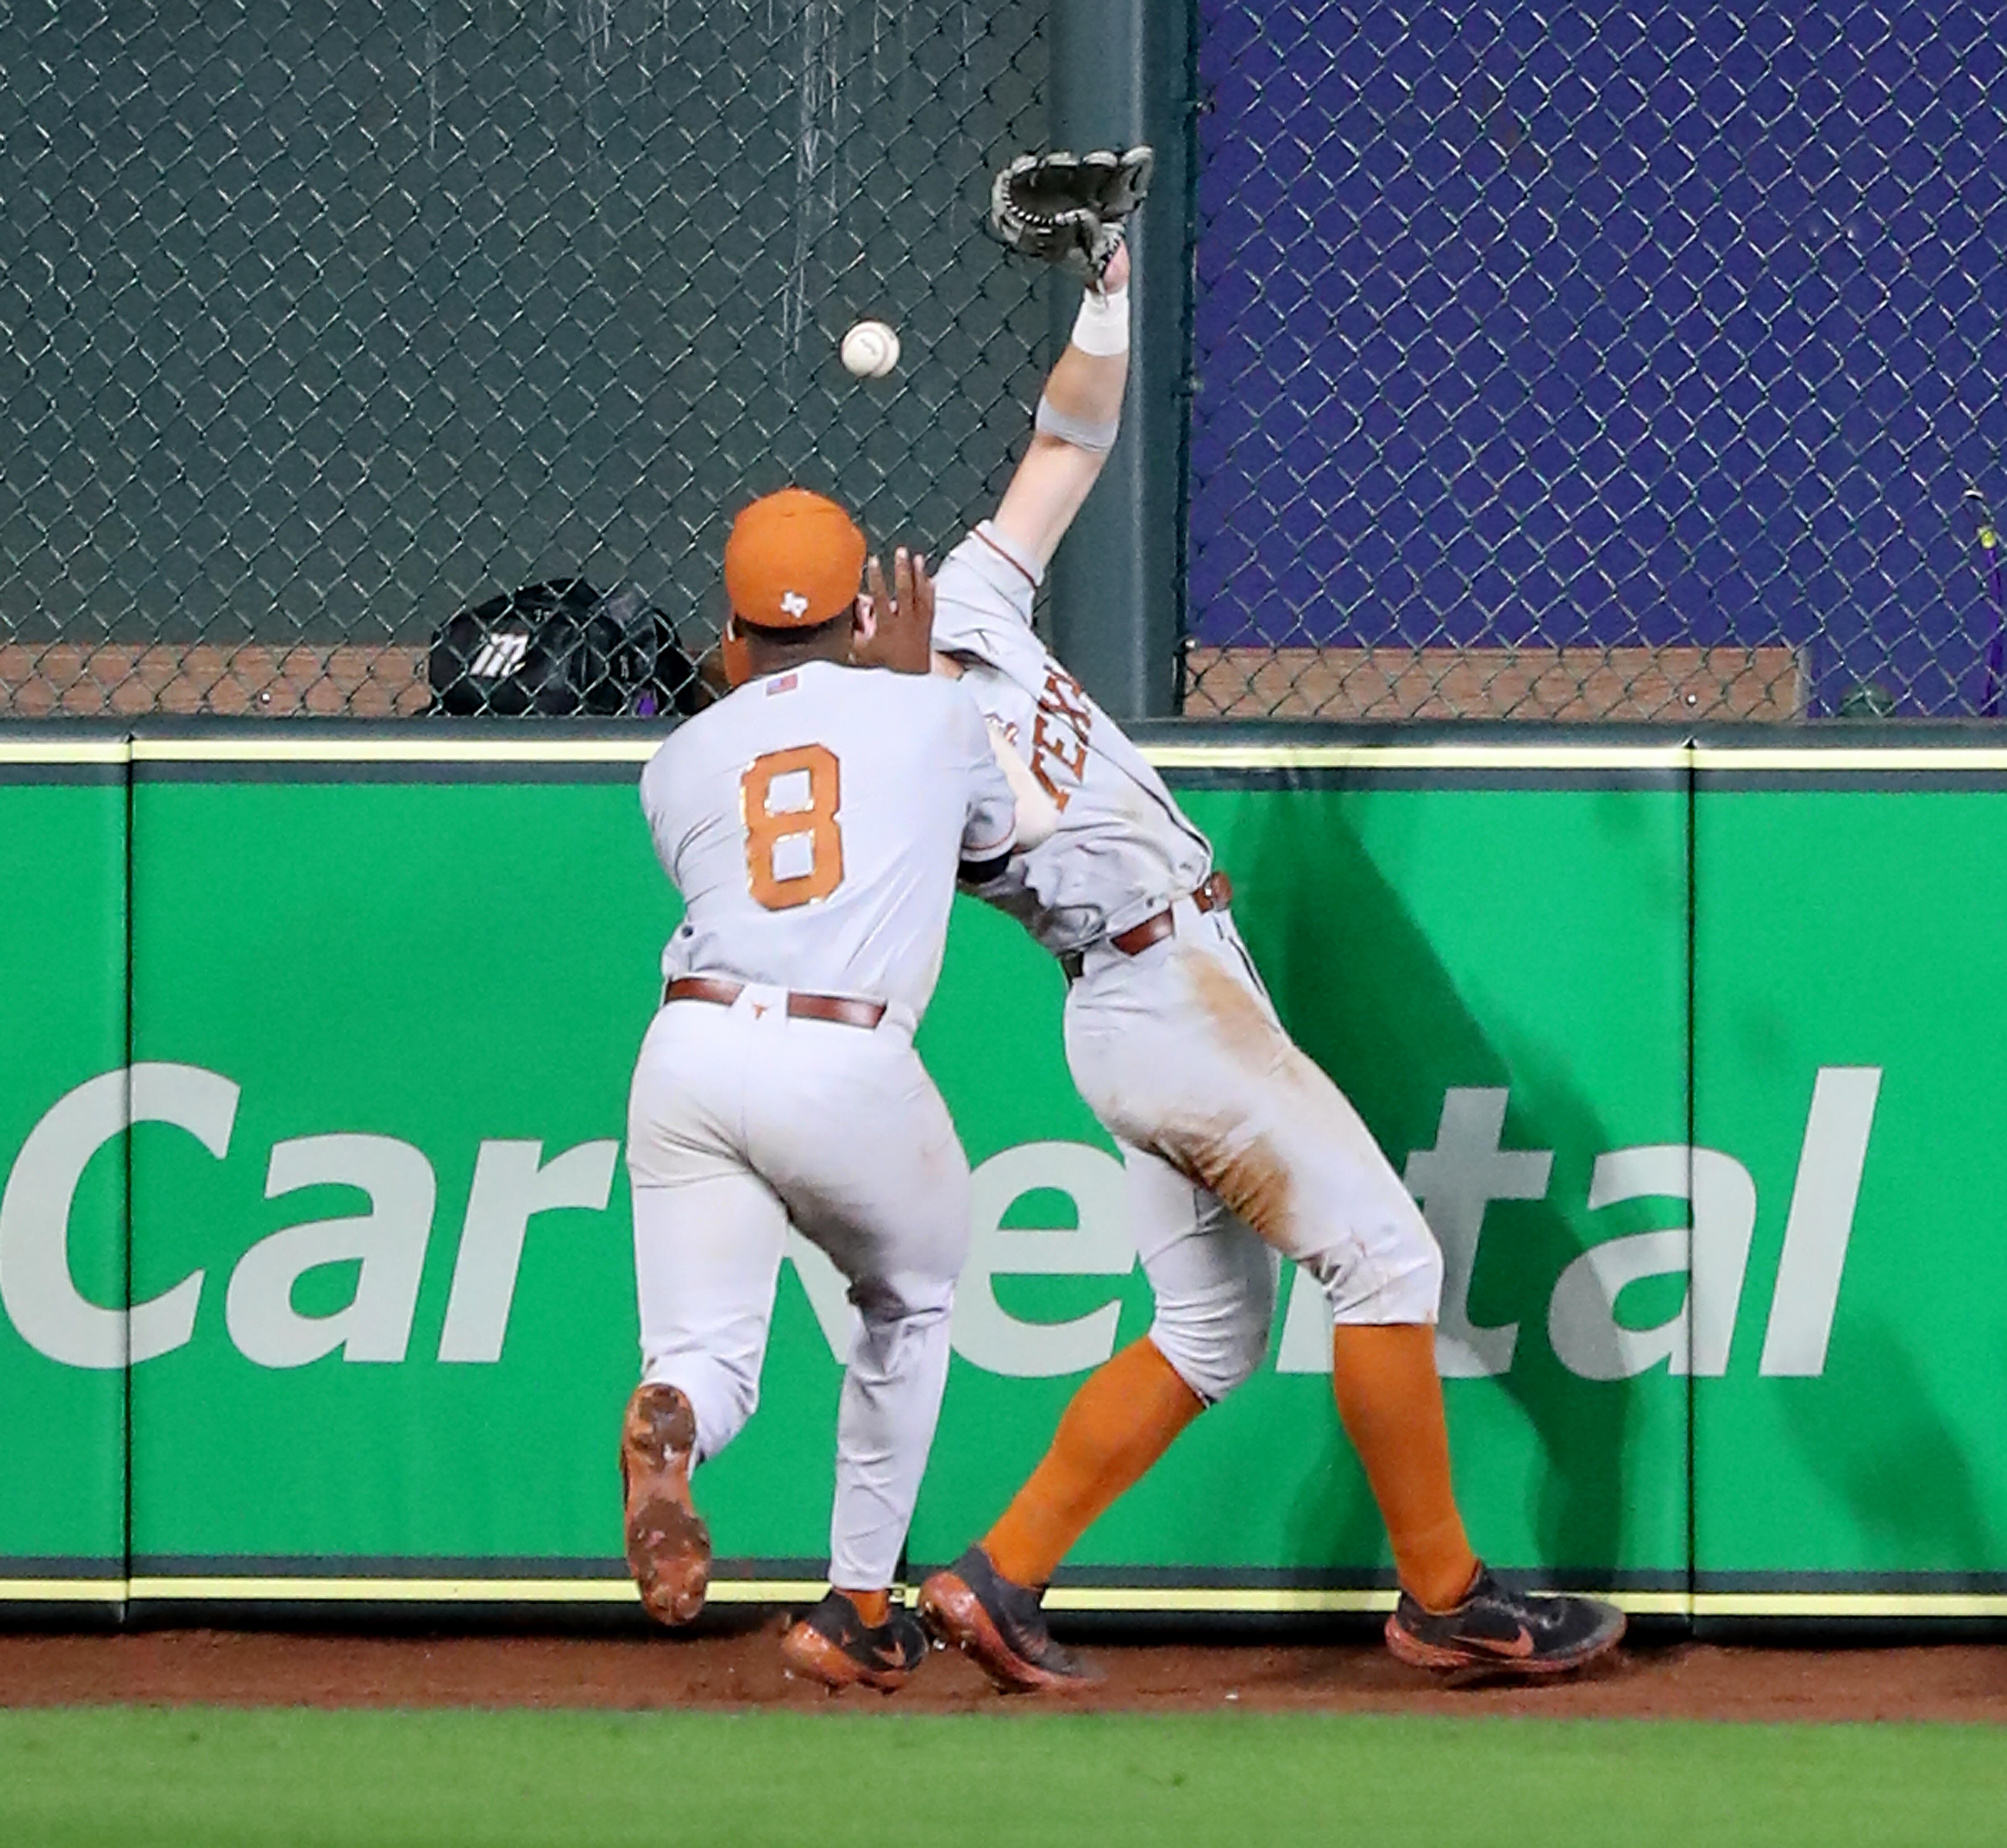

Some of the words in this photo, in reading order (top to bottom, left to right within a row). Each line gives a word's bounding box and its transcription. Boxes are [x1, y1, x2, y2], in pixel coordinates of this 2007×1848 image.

[740, 742, 845, 912] 8
[0, 1060, 620, 1370] Car
[780, 1065, 1883, 1382] etal
